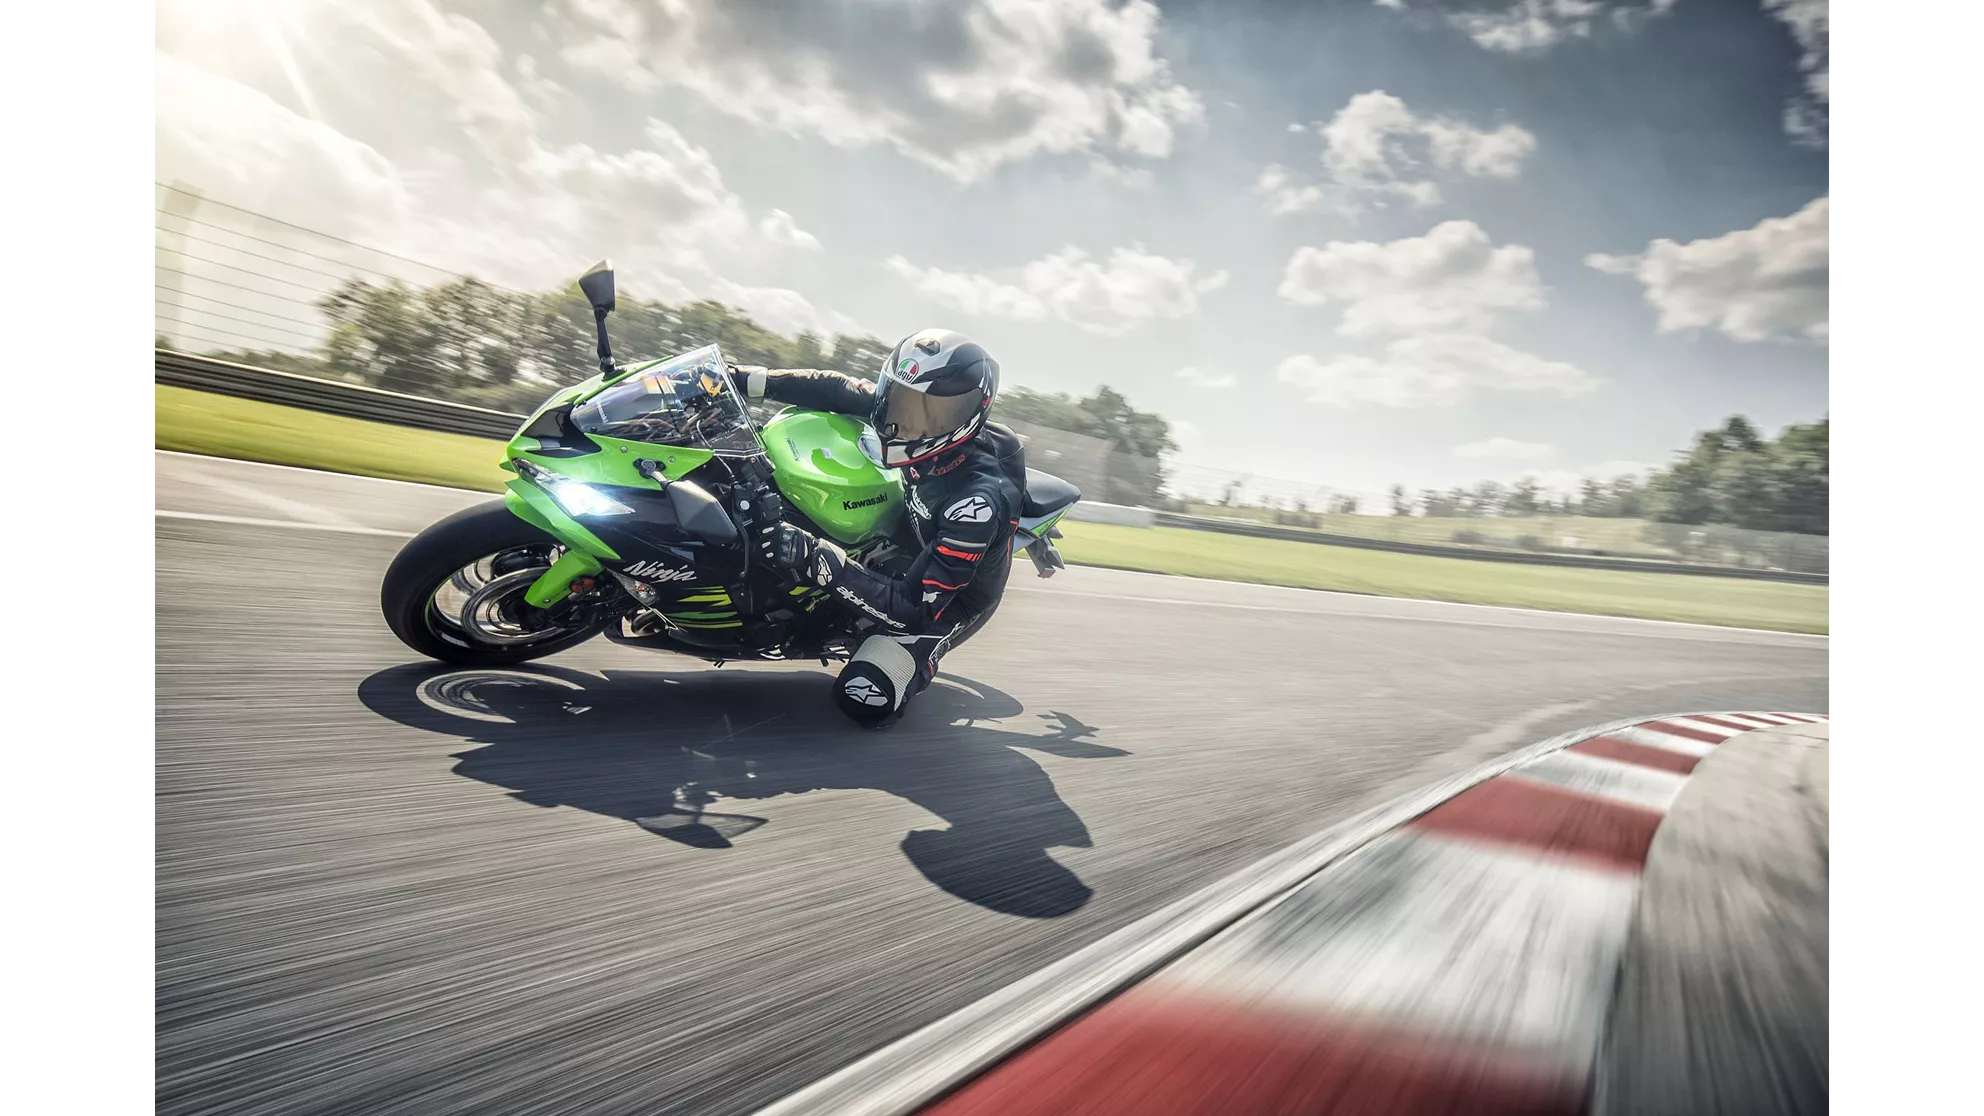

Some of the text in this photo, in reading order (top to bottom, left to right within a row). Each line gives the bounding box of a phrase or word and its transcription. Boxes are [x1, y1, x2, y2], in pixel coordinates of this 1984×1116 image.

[842, 492, 888, 511] Kawasaki
[622, 560, 698, 584] Ninja
[836, 585, 907, 629] alpinestars
